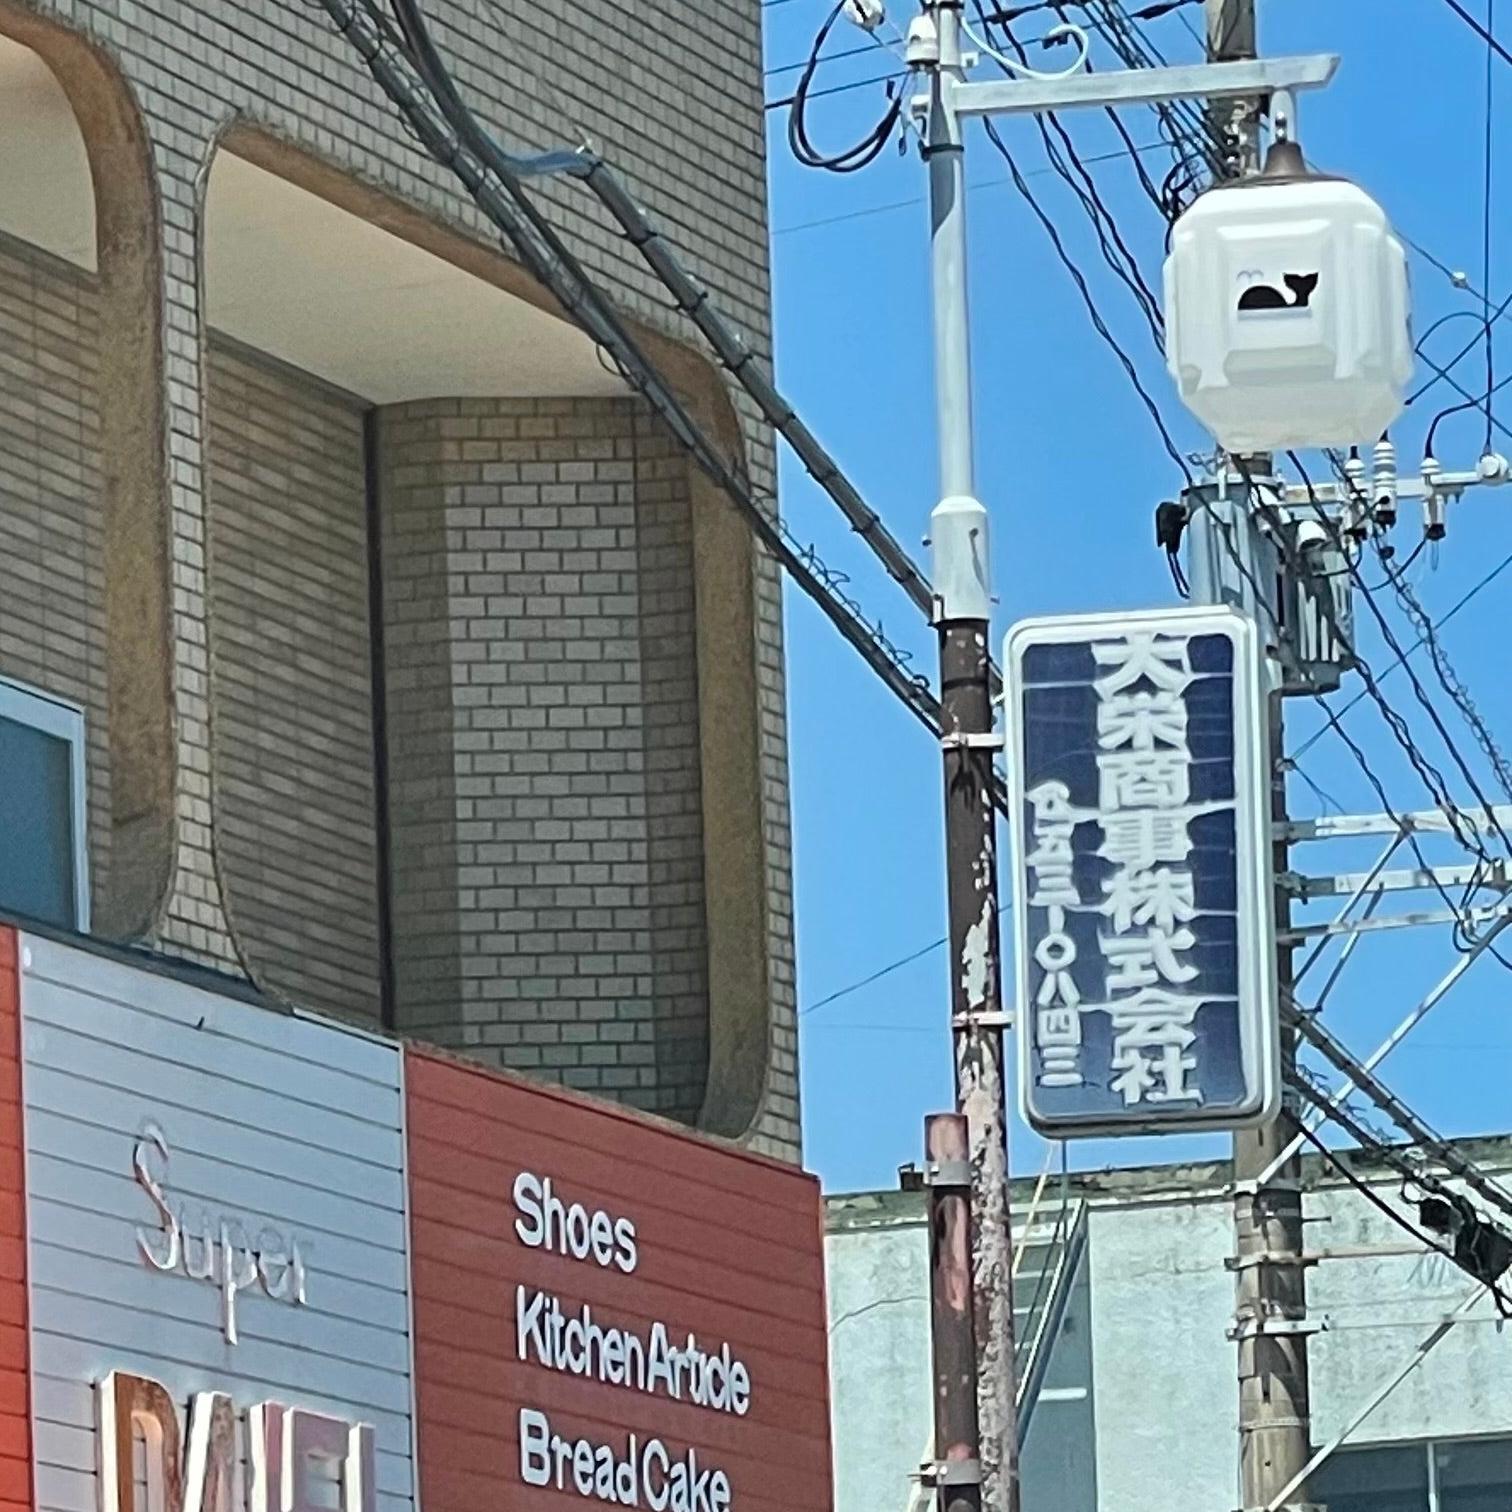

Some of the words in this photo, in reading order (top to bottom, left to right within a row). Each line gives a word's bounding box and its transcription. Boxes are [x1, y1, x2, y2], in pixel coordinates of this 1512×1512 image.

[1090, 632, 1203, 1106] 大栄商事株式会社
[133, 1116, 312, 1345] Super
[512, 1172, 638, 1273] Shoes
[516, 1284, 645, 1390] Kitchen
[646, 1321, 751, 1416] Article
[520, 1407, 638, 1507] Bread
